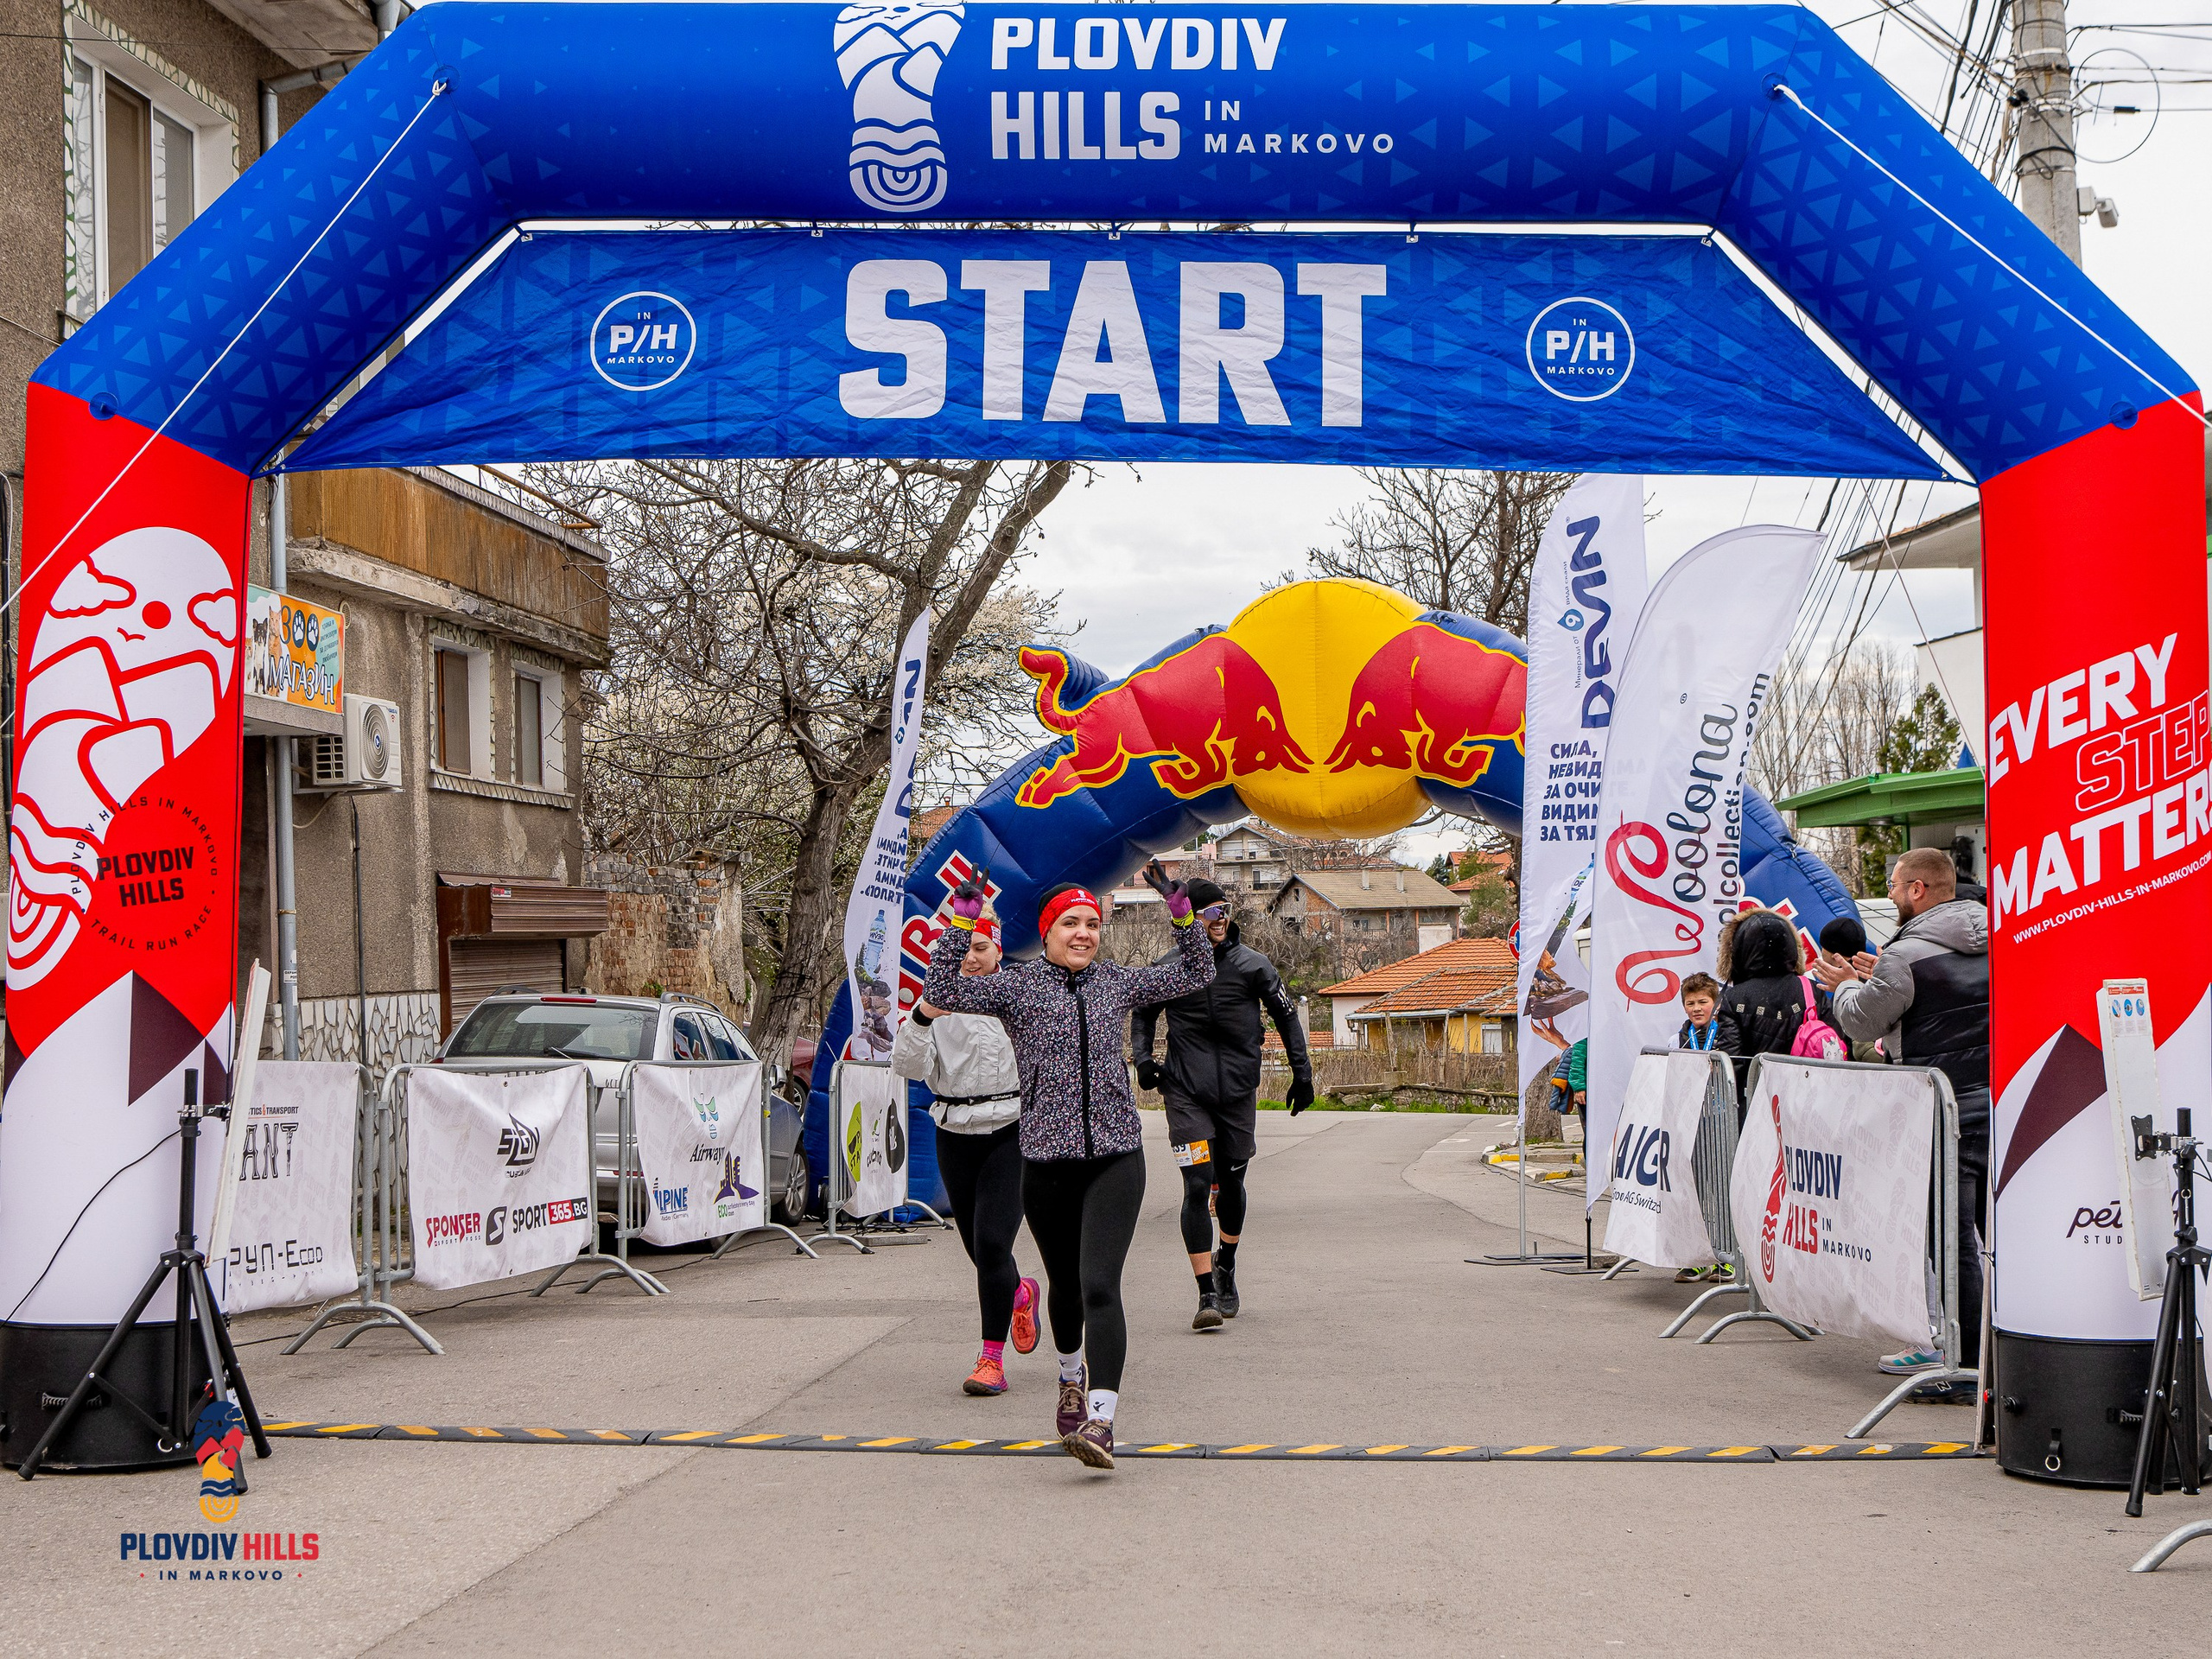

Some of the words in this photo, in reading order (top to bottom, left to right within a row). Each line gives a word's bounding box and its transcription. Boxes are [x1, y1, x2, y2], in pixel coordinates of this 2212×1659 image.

[991, 17, 1287, 71] PLOVDIV
[1205, 100, 1241, 121] IN
[991, 91, 1180, 160] HILLS
[1205, 132, 1395, 155] MARKOVO
[1573, 318, 1587, 327] IN
[609, 324, 678, 353] P/H
[838, 259, 1388, 428] START
[1546, 330, 1615, 364] P/H
[607, 355, 676, 365] MARKOVO
[1546, 365, 1615, 376] MARKOVO
[268, 653, 335, 705] МАГАЗИН
[1988, 632, 2178, 789] EVERY
[2075, 689, 2209, 812] STEP
[159, 797, 175, 810] IN
[1543, 783, 1561, 799] ЗА
[1565, 782, 1601, 798] ОЧИ
[1541, 804, 1599, 823] ВИДИ
[1540, 825, 1561, 842] ЗА
[96, 846, 194, 881] PLOVDIV
[118, 877, 185, 907] HILLS
[2012, 850, 2212, 944] WWW.PLOVDIV-HILLS-IN-MARKOVO.COM
[91, 918, 135, 950] TRAIL
[146, 937, 178, 950] RUN
[184, 906, 212, 939] RACE
[1784, 1145, 1842, 1200] PLOVDIV
[425, 1212, 481, 1249] SPONSER
[1821, 1217, 1832, 1232] IN
[2083, 1234, 2123, 1244] STUD
[1822, 1239, 1872, 1262] MARKOVO
